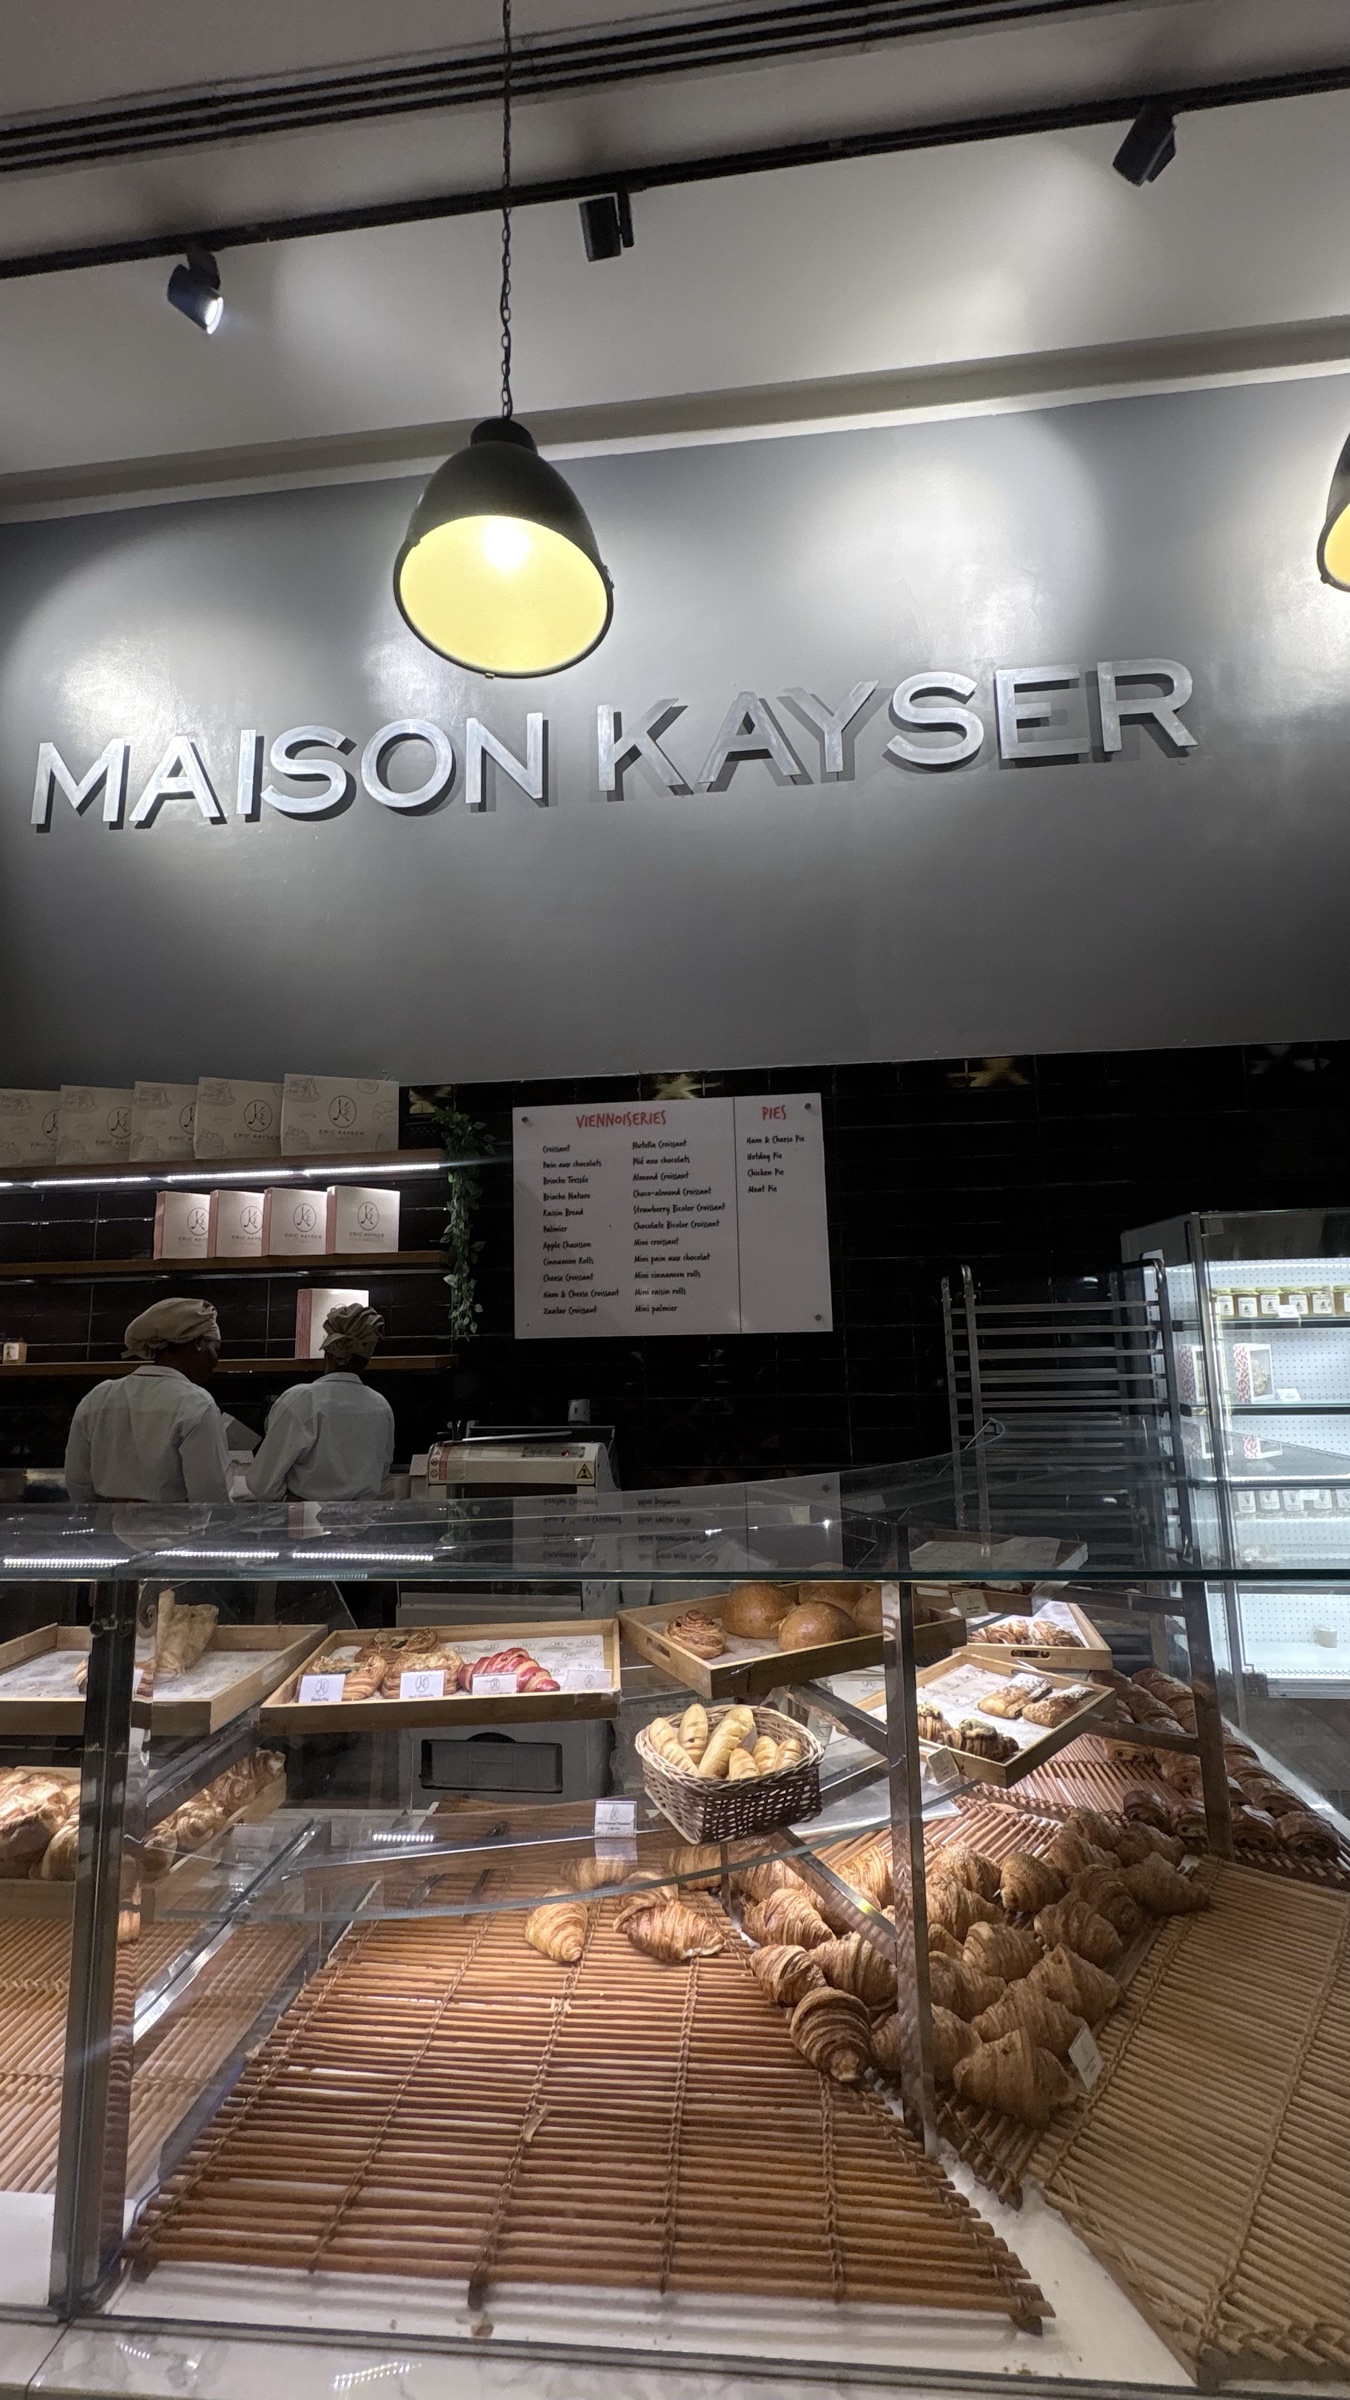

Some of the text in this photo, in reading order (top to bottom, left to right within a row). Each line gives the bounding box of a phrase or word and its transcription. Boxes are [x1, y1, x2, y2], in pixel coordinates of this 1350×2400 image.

[30, 658, 1199, 825] MAISON KAYSER
[762, 1105, 786, 1120] PIES
[576, 1110, 666, 1128] VIENNOISERIES
[632, 1139, 686, 1150] Nutella Croissant
[772, 1135, 793, 1144] Cheese
[543, 1144, 570, 1153] Croissant
[660, 1155, 690, 1164] chocolats
[773, 1152, 782, 1160] Pie
[543, 1161, 556, 1169] Pain
[573, 1159, 601, 1167] chocolats
[632, 1171, 689, 1181] Almond Croissant
[748, 1168, 784, 1178] Chicken Pie
[543, 1176, 566, 1185] Brioche
[633, 1186, 712, 1198] Choco-almond Croissant
[748, 1184, 765, 1193] Meat
[543, 1192, 590, 1201] Brioche Nature
[543, 1208, 584, 1217] Raisin Bread
[633, 1202, 726, 1216] Strawberry Bicolor Croissant
[634, 1219, 720, 1230] Chocolate Bicolor Croissant
[543, 1241, 591, 1252] Apple Chausson
[650, 1237, 679, 1246] croissant
[543, 1258, 576, 1266] Cinnamon
[634, 1255, 648, 1263] Mini
[651, 1255, 666, 1265] pain
[683, 1252, 710, 1261] chocolat
[543, 1272, 594, 1282] Cheese Croissant
[687, 1270, 701, 1278] rolls
[568, 1290, 588, 1298] Cheese
[591, 1288, 619, 1298] Croissant
[652, 1288, 670, 1296] raisin
[672, 1287, 686, 1295] rolls
[568, 1305, 597, 1315] Croissant
[652, 1304, 677, 1315] palmier
